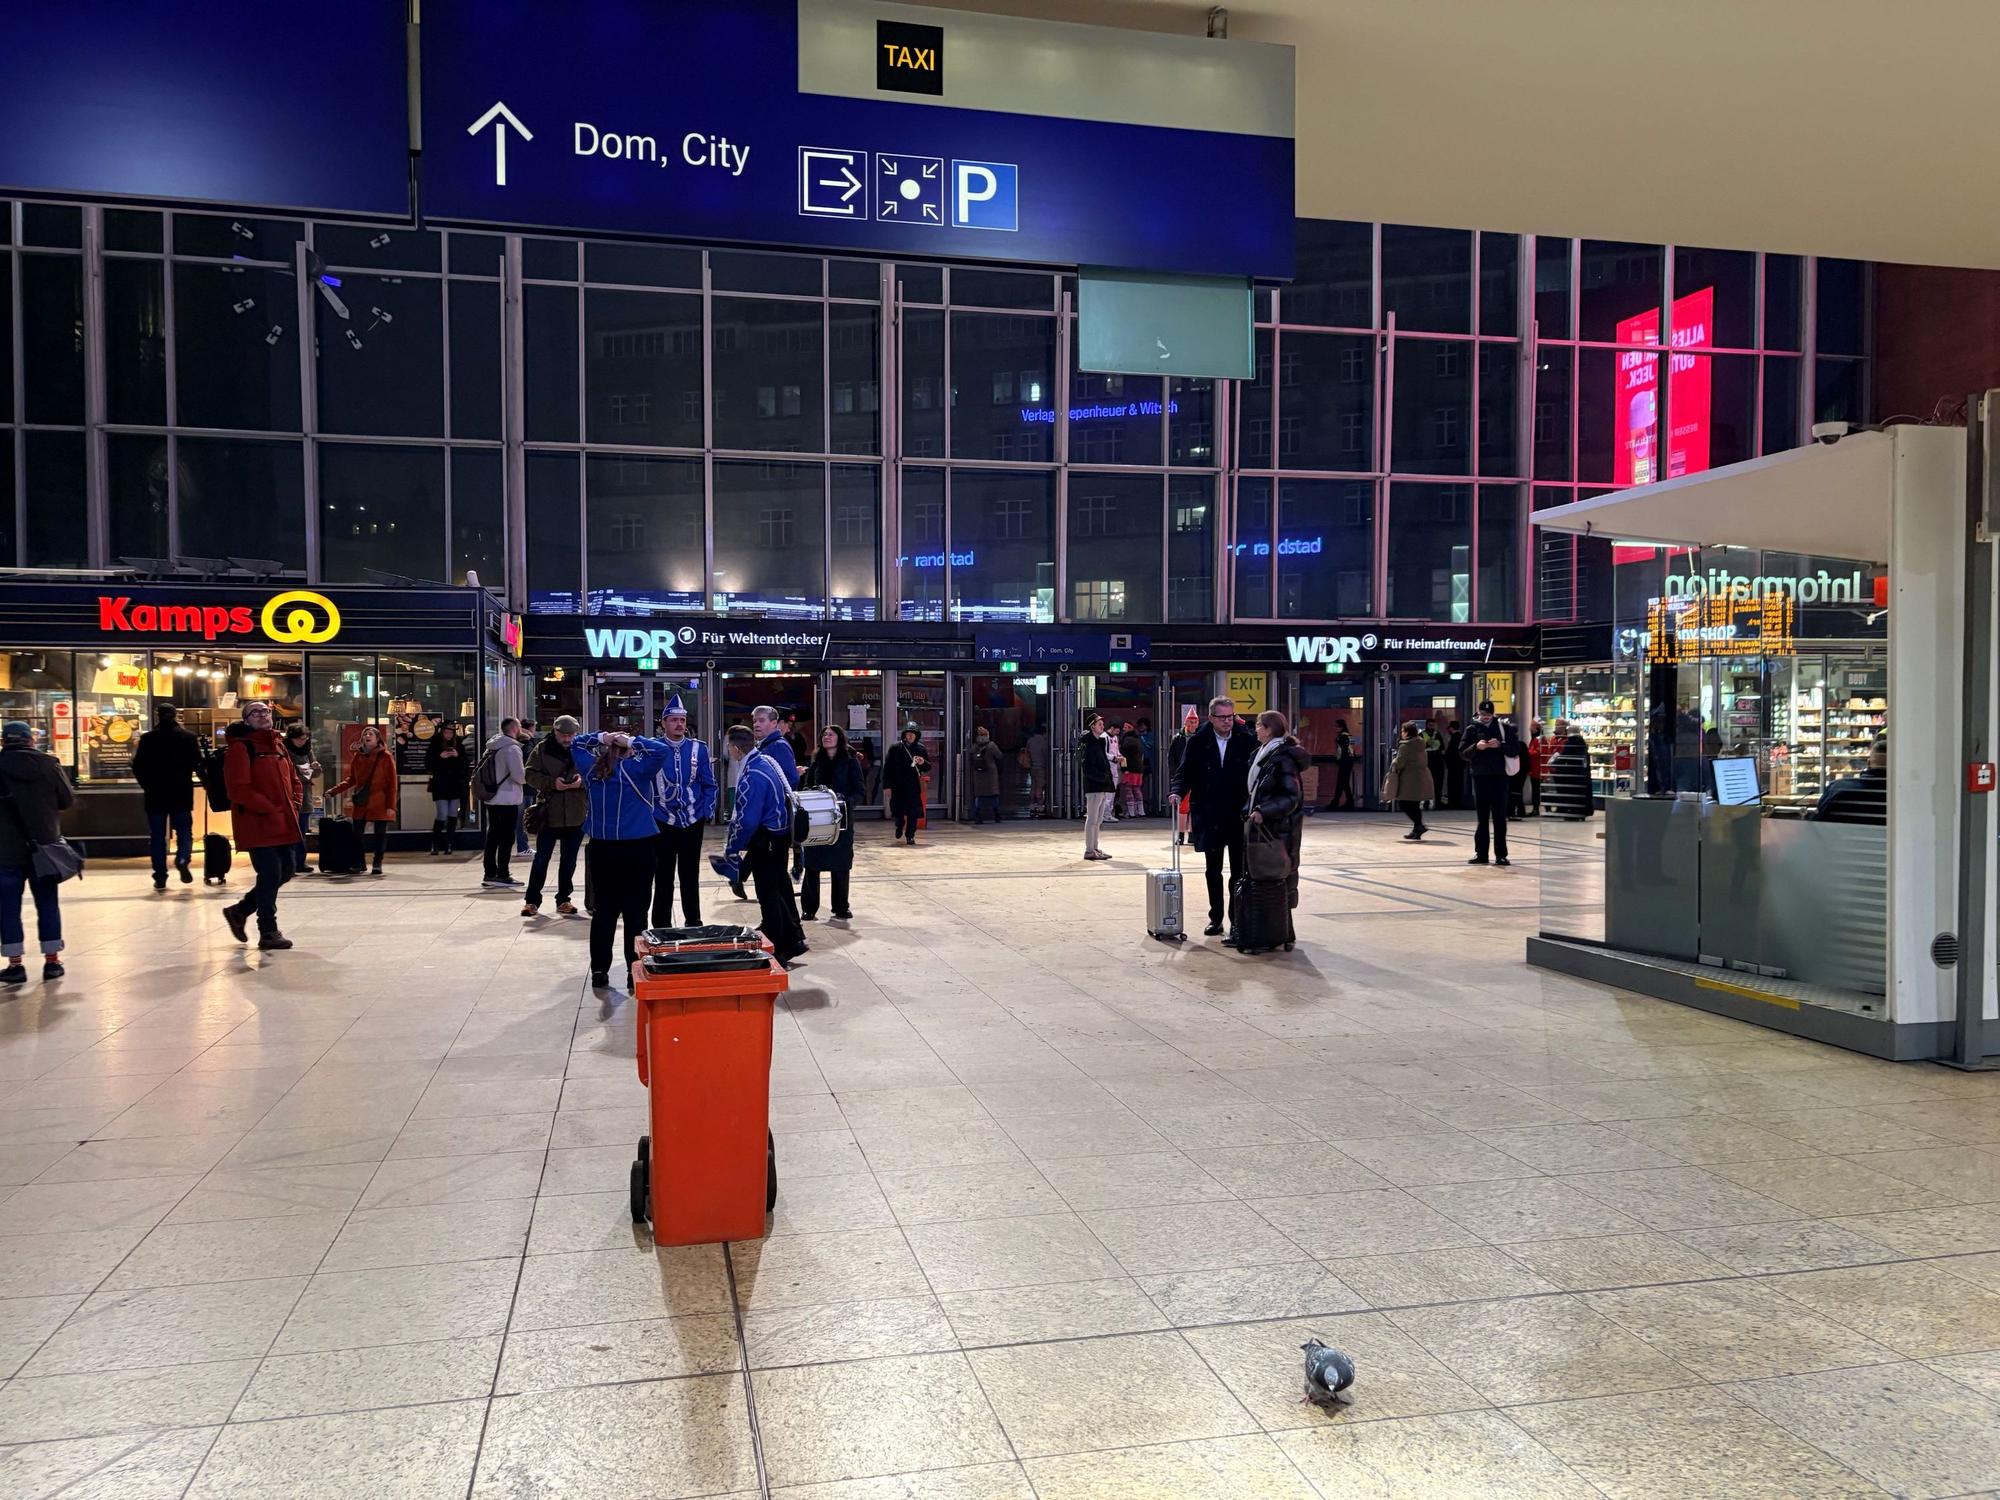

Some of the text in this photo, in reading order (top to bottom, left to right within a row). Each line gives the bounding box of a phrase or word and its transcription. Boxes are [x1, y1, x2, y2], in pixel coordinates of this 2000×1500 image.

[884, 44, 935, 71] TAXI
[574, 122, 750, 176] Dom, City
[958, 165, 998, 223] P
[1021, 409, 1055, 423] Verlag
[1062, 404, 1127, 421] epenheuer
[1129, 403, 1138, 416] &
[915, 550, 974, 567] randtad
[1253, 537, 1322, 556] radstad
[98, 596, 255, 641] Kamps
[584, 628, 678, 659] WDR
[702, 632, 726, 644] Für
[728, 632, 824, 646] Weltentdecker
[1286, 636, 1362, 663] WDR
[1384, 638, 1404, 649] Für
[1406, 638, 1487, 650] Heimatfreunde
[1231, 677, 1263, 690] EXIT
